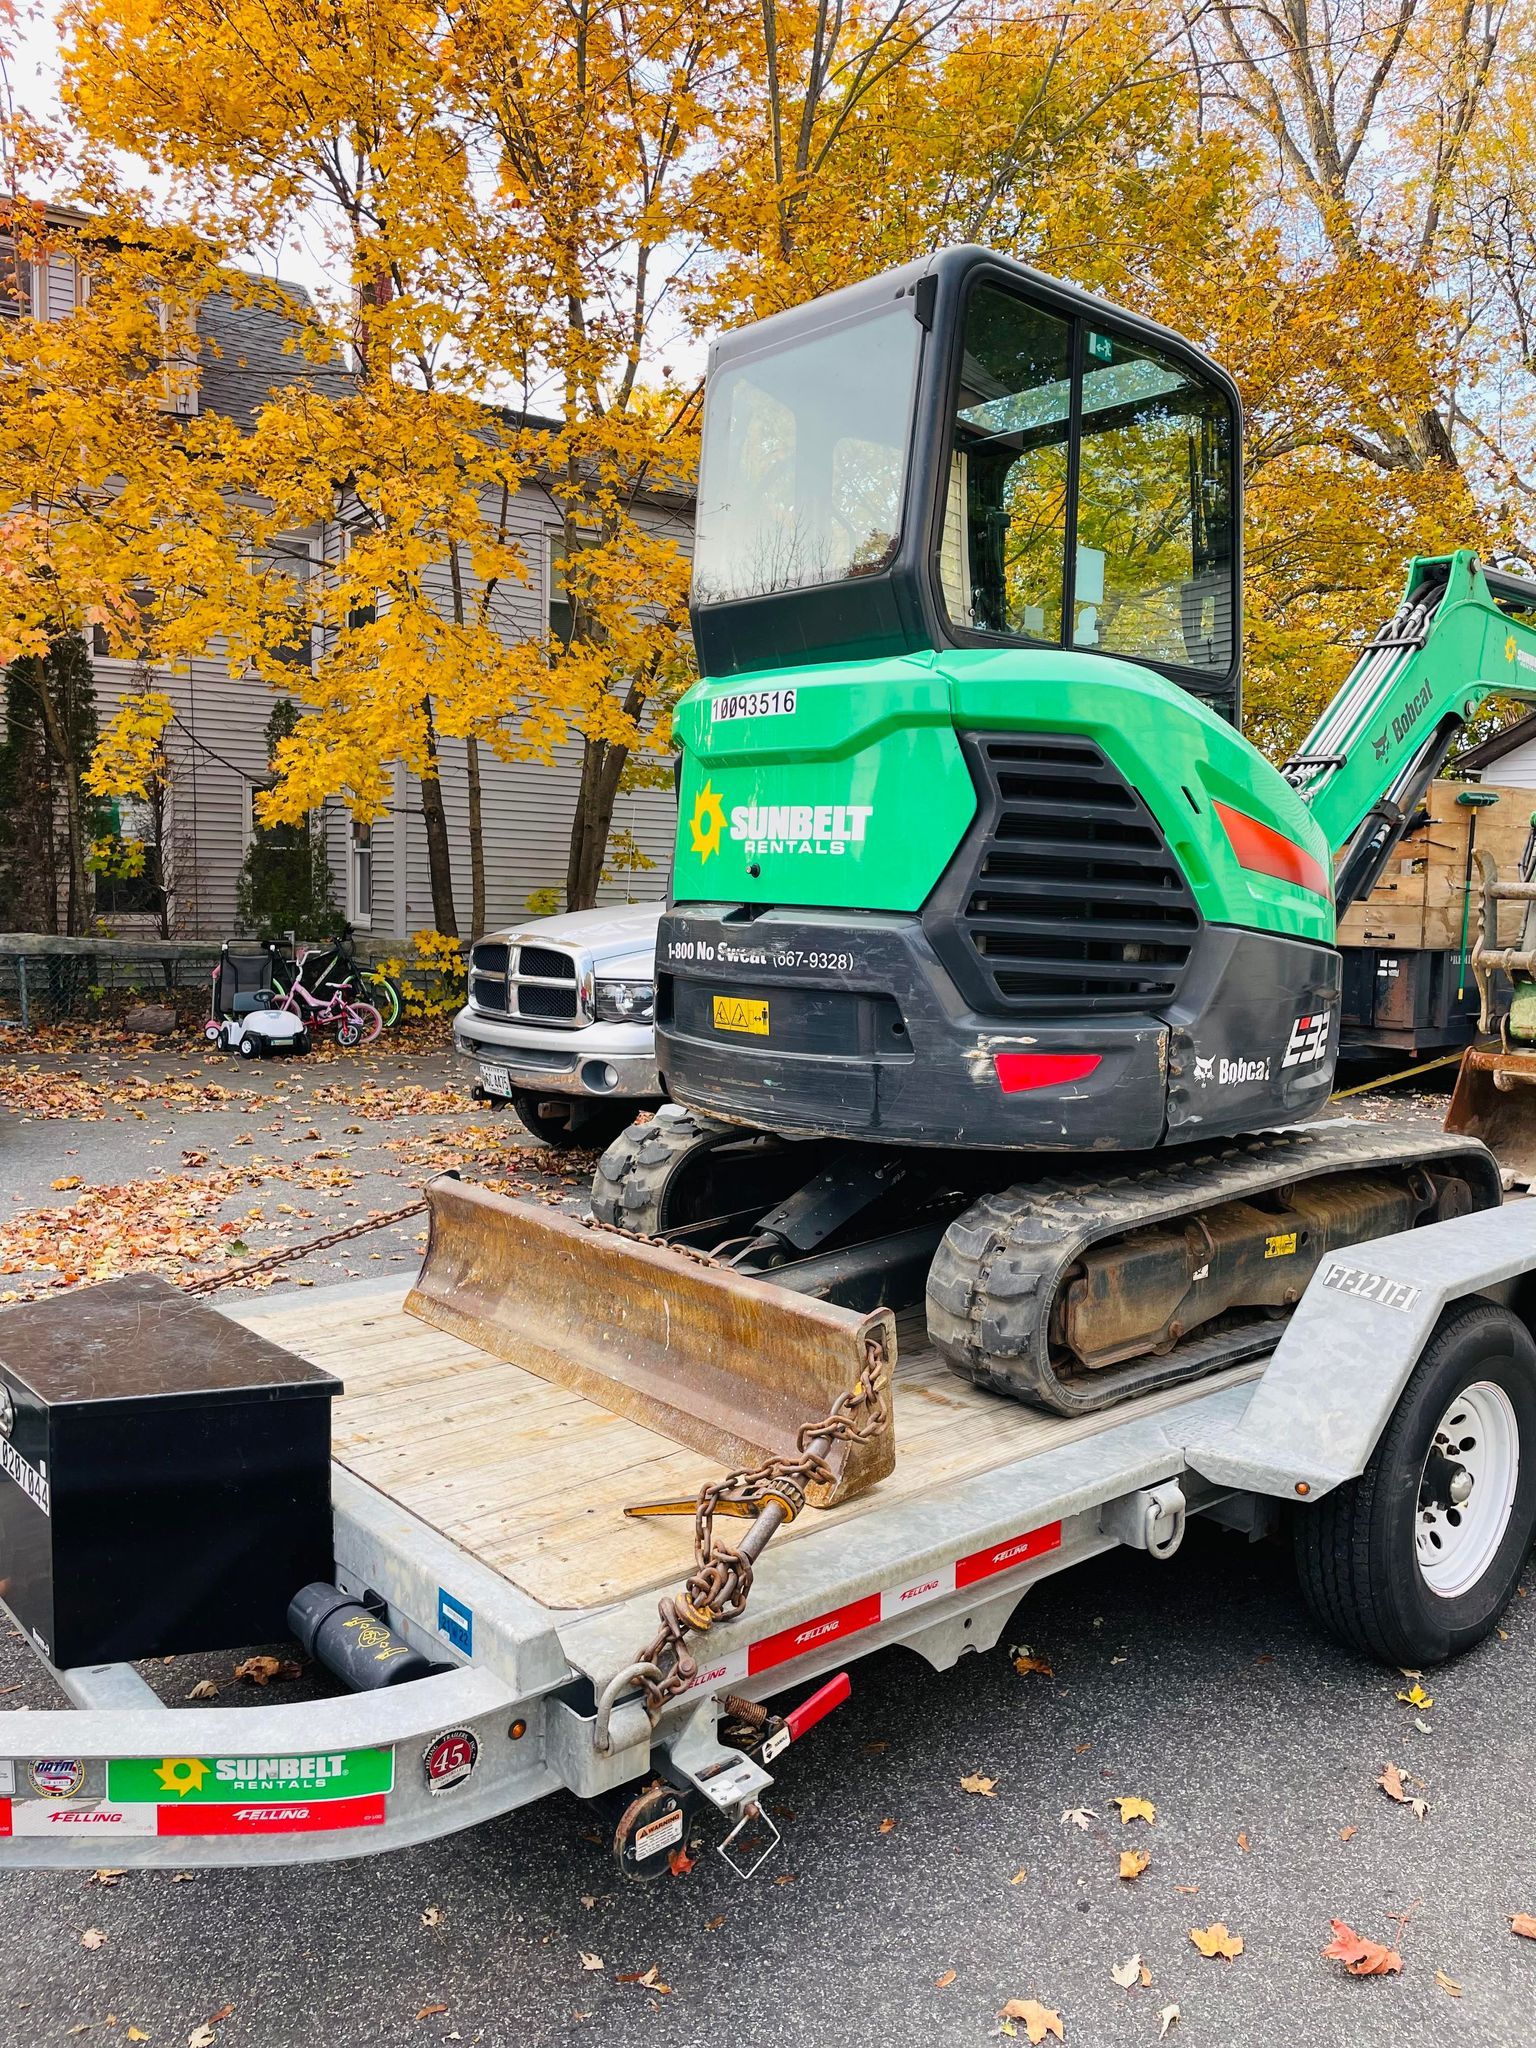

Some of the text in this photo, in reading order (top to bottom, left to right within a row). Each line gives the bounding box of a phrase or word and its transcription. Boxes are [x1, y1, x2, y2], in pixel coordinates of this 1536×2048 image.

[713, 690, 795, 720] 10093516
[1392, 677, 1433, 744] Bobcat
[730, 806, 873, 841] SUNBELT
[745, 841, 845, 855] RENTALS
[667, 942, 694, 960] 1-800
[697, 941, 714, 961] No
[772, 950, 854, 971] (667-9328)
[1281, 1010, 1331, 1069] E32
[1218, 1056, 1271, 1086] Bobcat
[1324, 1264, 1381, 1298] FT-12
[991, 1543, 1029, 1564] FELLING
[898, 1580, 939, 1601] FELLING
[794, 1620, 840, 1645] FELLING
[688, 1666, 727, 1689] ELLING
[36, 1761, 75, 1772] NATM
[215, 1755, 347, 1781] SUNBELT
[433, 1743, 464, 1773] 45
[234, 1779, 327, 1790] RENTALS
[46, 1811, 123, 1823] FELLING
[232, 1807, 310, 1821] FELLING
[648, 1814, 680, 1834] WARNING
